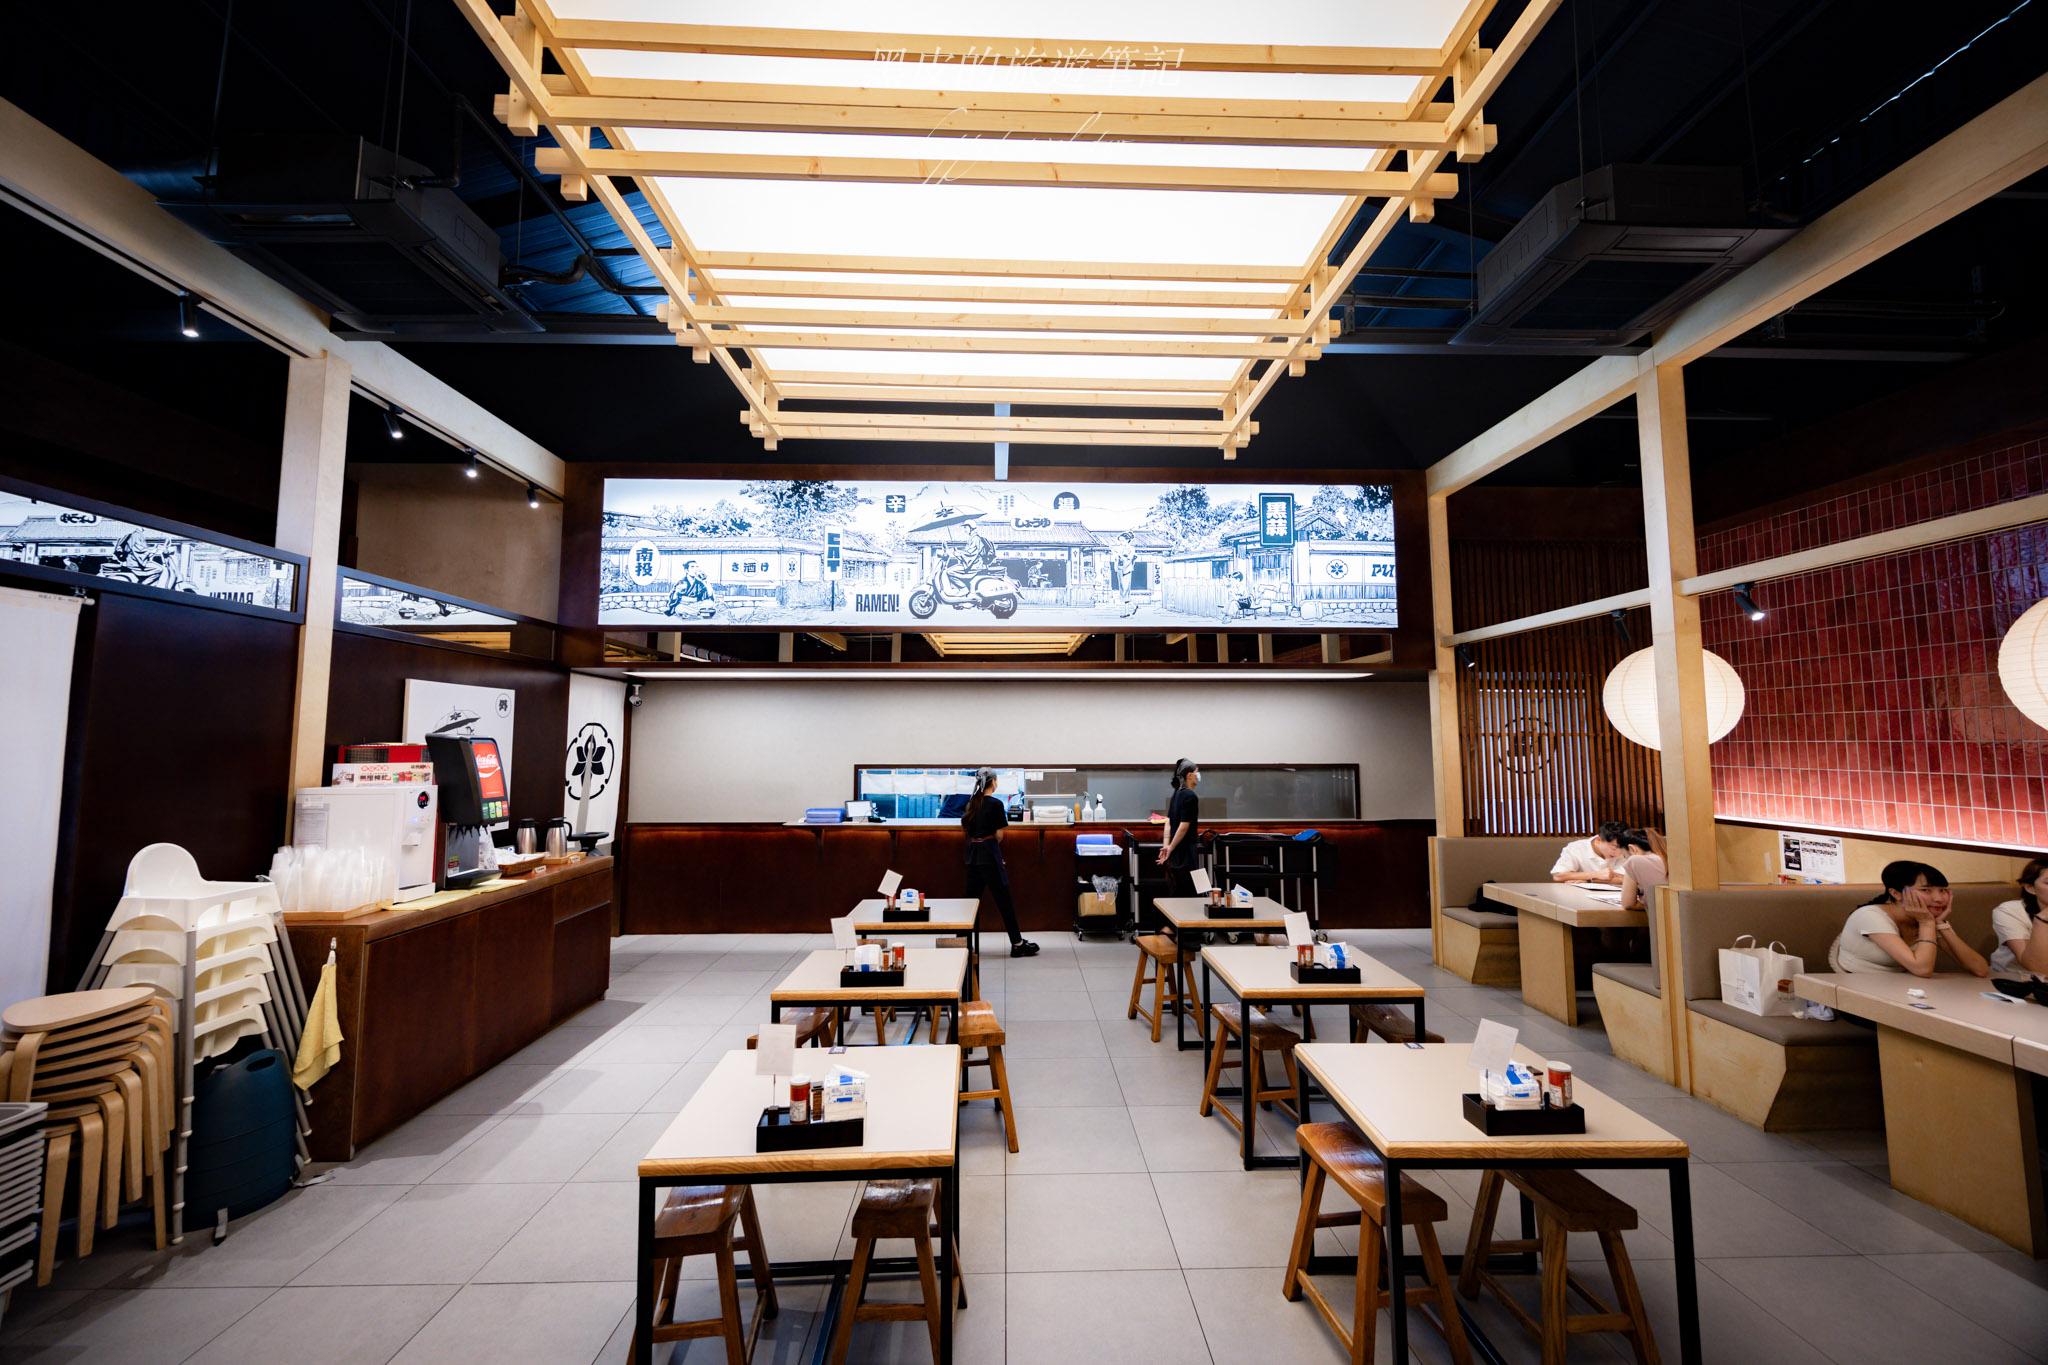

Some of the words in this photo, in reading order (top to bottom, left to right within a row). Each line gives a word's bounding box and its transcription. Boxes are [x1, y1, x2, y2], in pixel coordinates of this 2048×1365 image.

[1014, 517, 1051, 529] しょうゆ
[635, 547, 653, 577] 南投
[855, 593, 900, 612] RAMEN!
